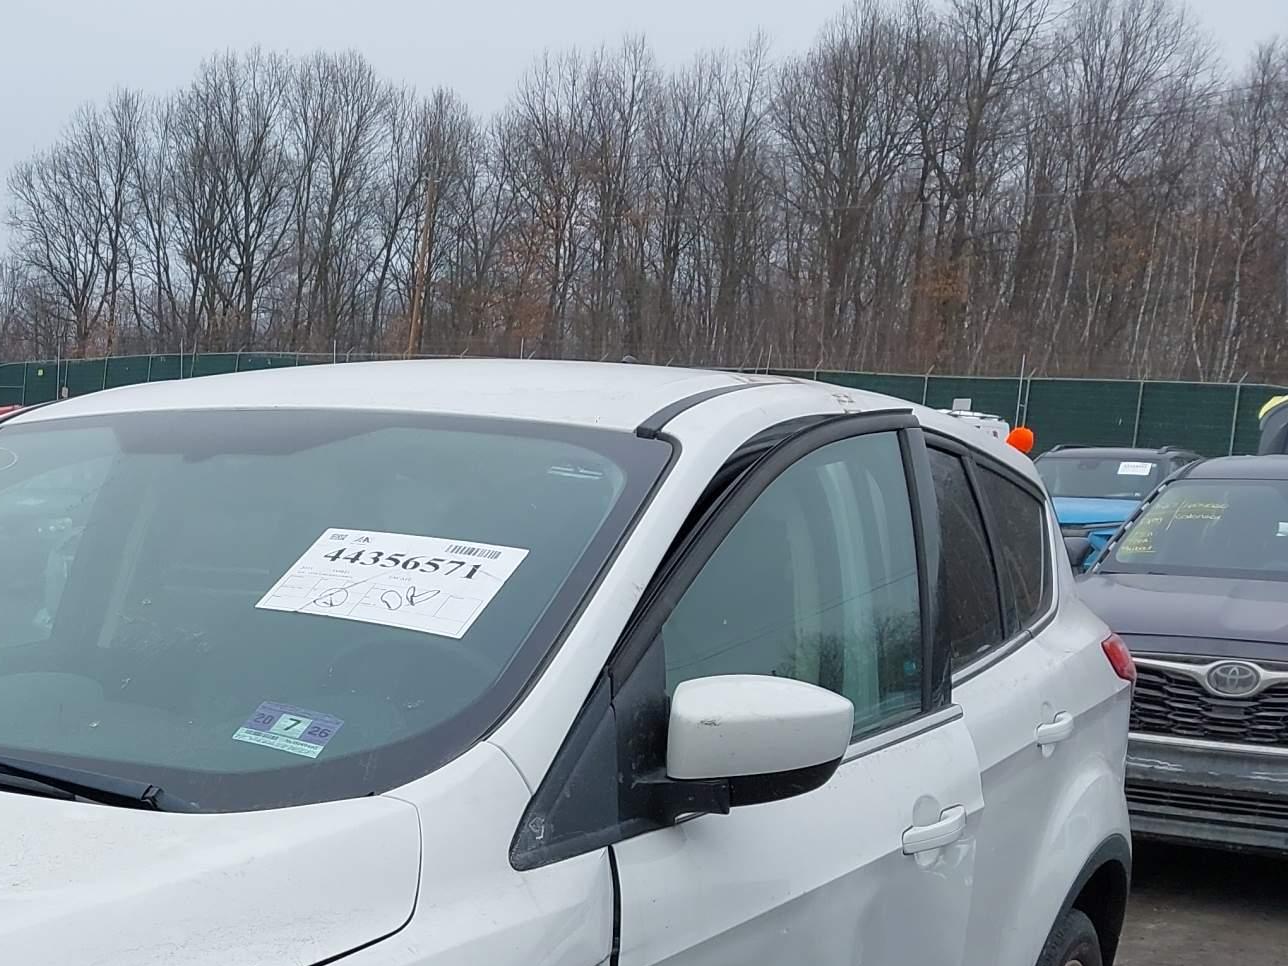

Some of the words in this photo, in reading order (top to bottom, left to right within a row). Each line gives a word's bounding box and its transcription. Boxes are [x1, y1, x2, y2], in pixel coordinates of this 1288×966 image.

[324, 547, 482, 580] 44356571
[254, 713, 274, 725] 20
[283, 717, 301, 731] 7
[308, 726, 331, 738] 26
